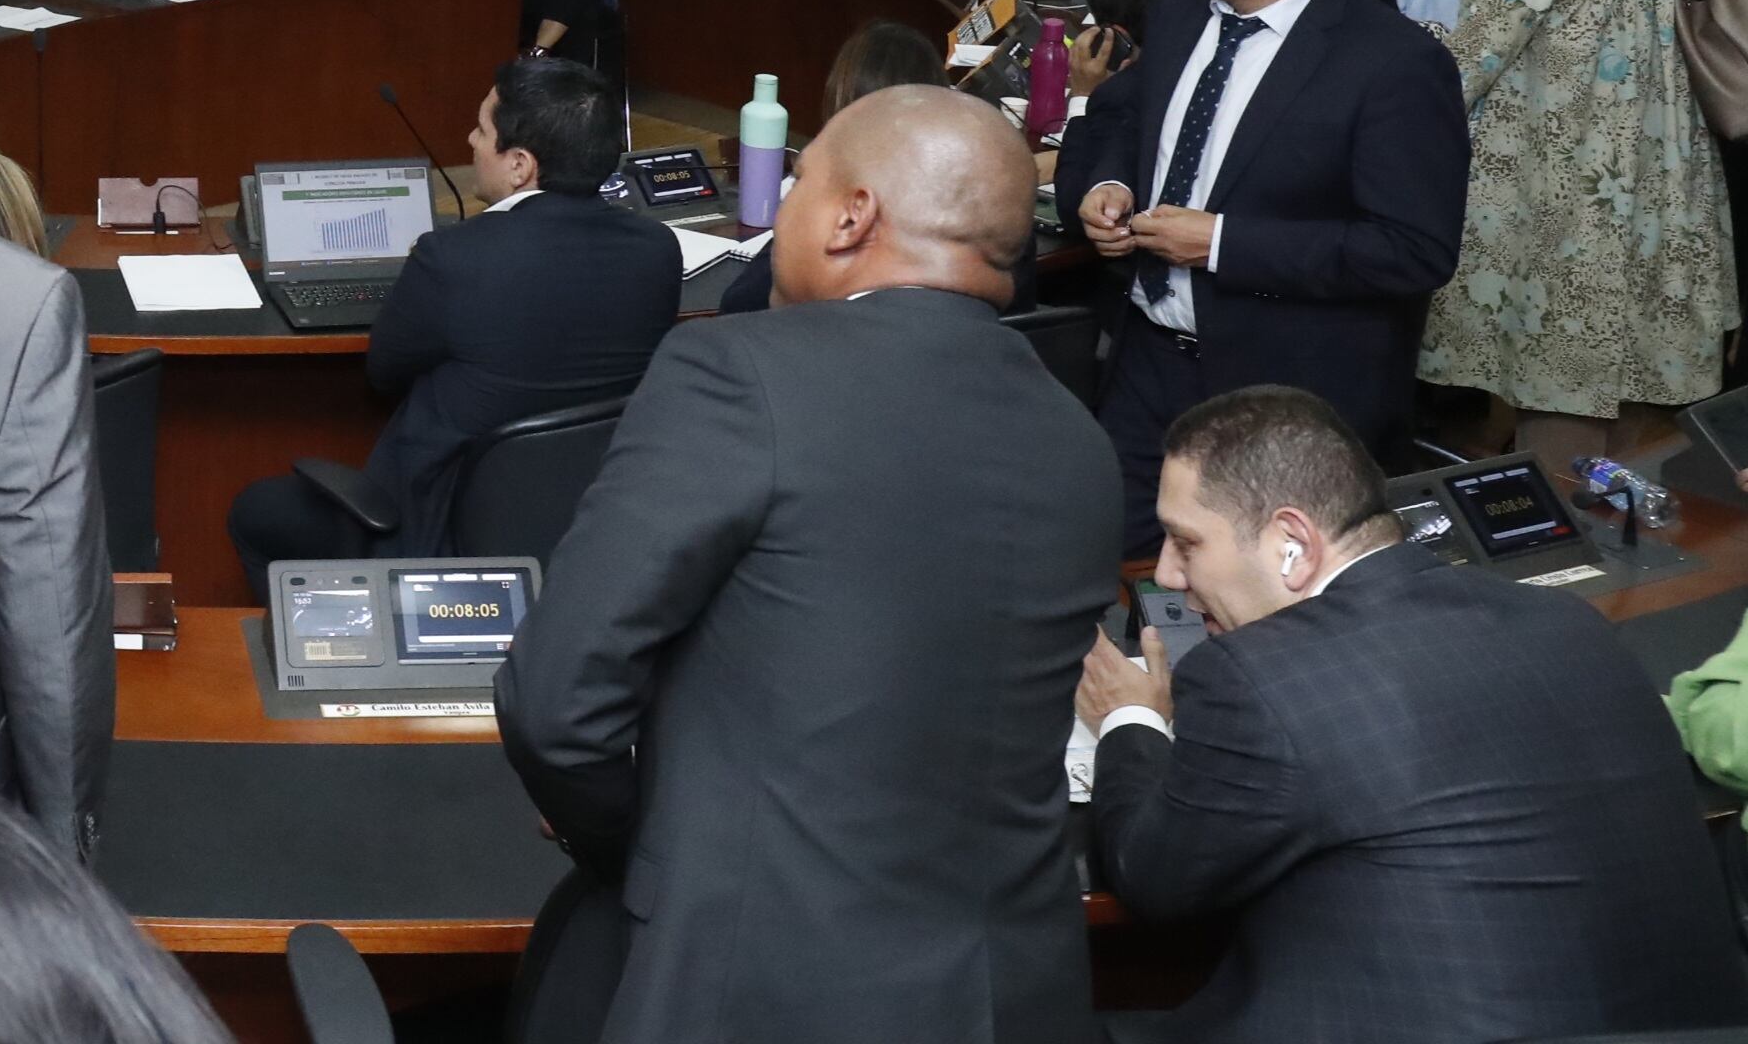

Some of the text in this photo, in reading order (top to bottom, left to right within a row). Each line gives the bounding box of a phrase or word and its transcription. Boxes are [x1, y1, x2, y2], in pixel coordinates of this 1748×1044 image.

[428, 603, 500, 619] 00:08:05
[371, 703, 411, 712] Camilo
[415, 702, 459, 711] Esteban
